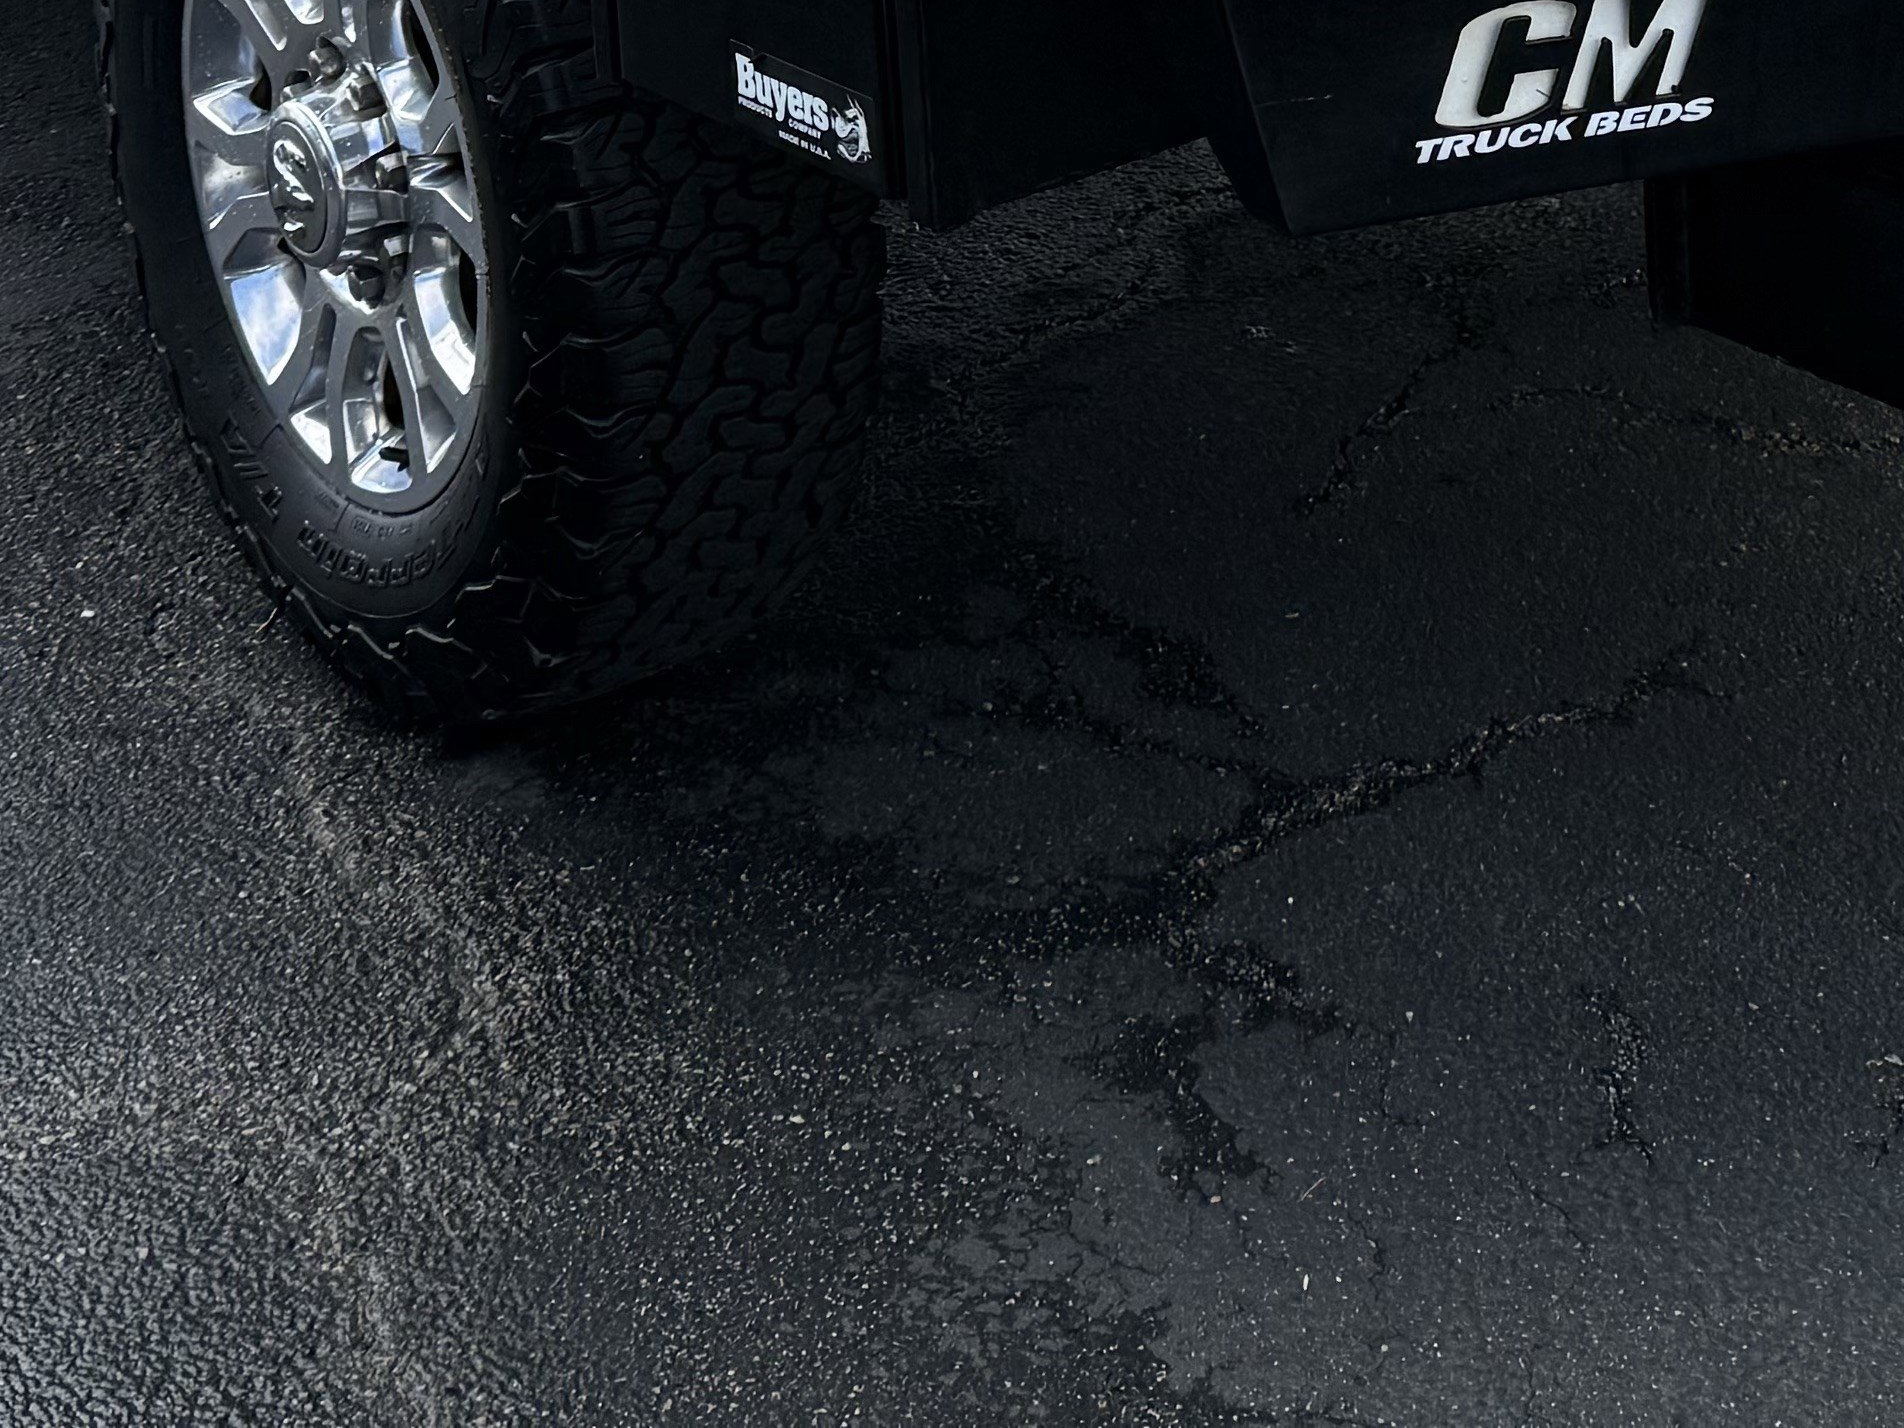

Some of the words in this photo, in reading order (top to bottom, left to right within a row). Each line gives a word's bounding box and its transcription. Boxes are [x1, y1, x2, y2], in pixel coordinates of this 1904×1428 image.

[736, 53, 830, 132] Buyers
[1415, 116, 1578, 164] TRUCK
[1584, 97, 1714, 137] BEDS
